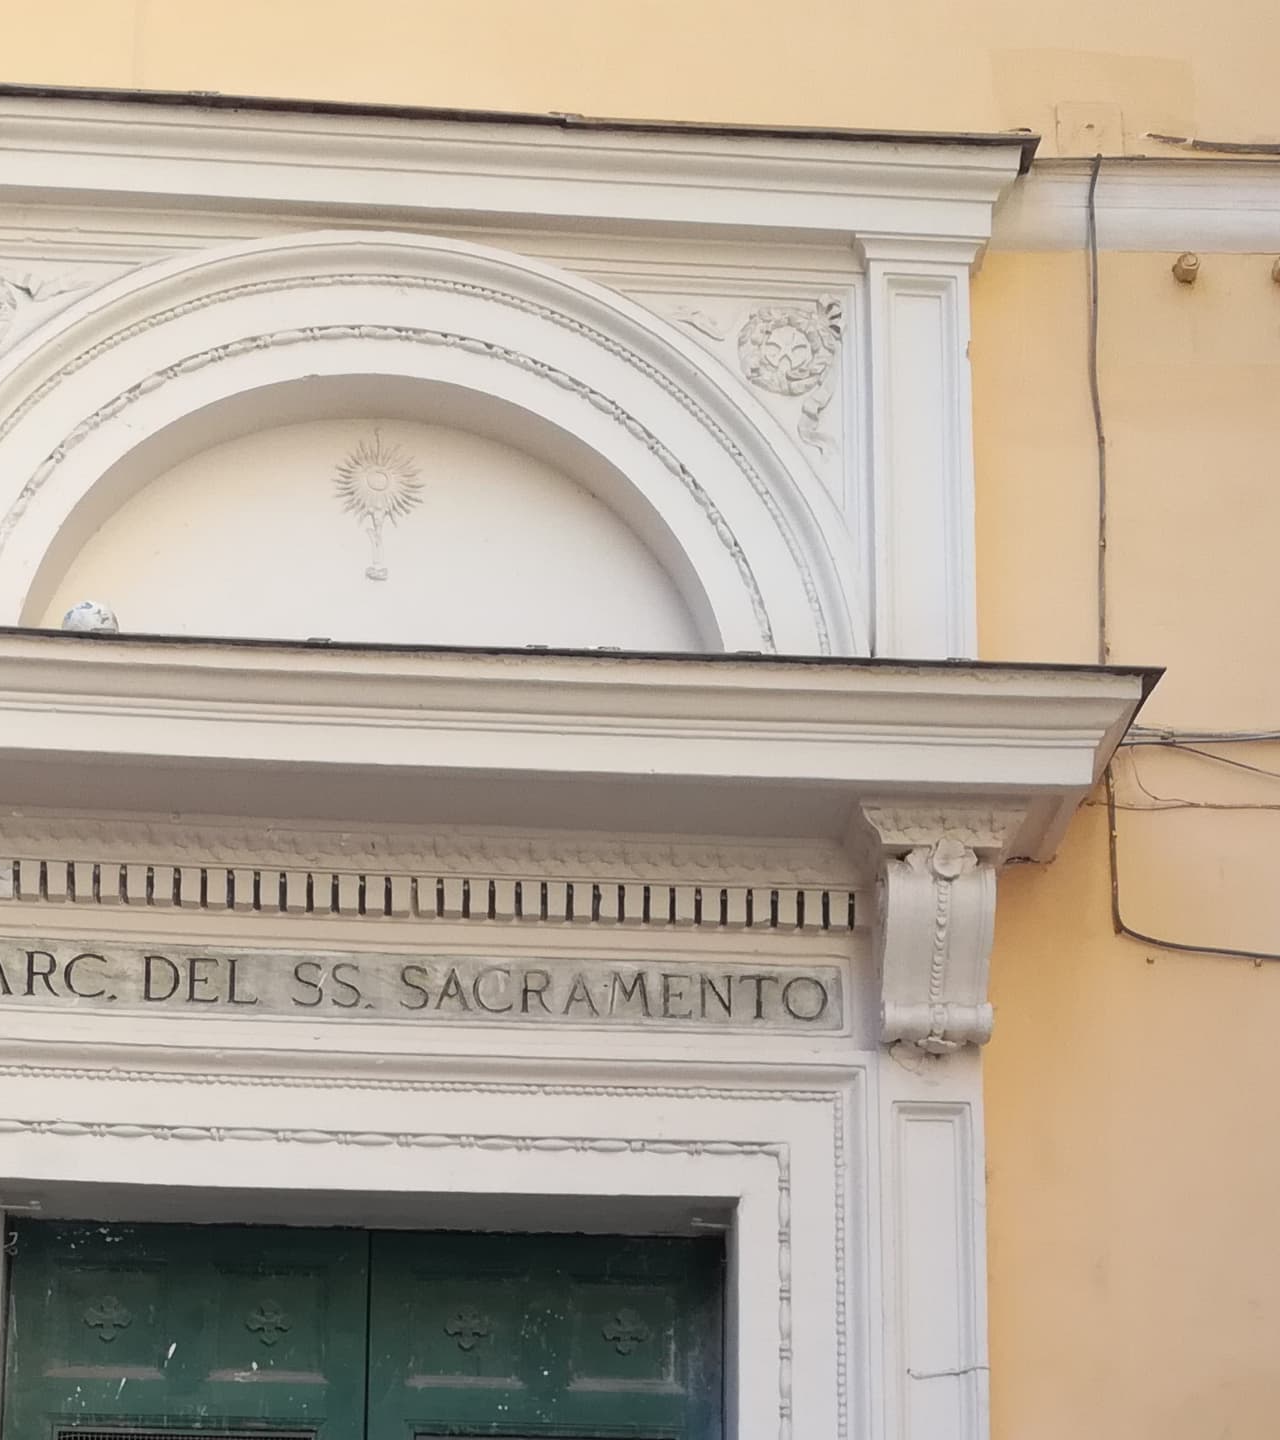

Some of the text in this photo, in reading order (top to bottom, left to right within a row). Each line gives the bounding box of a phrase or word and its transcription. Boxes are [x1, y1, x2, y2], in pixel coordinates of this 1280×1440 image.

[143, 955, 259, 1004] DEL
[292, 961, 376, 1009] SS.
[399, 964, 829, 1022] SACRAMENTO
